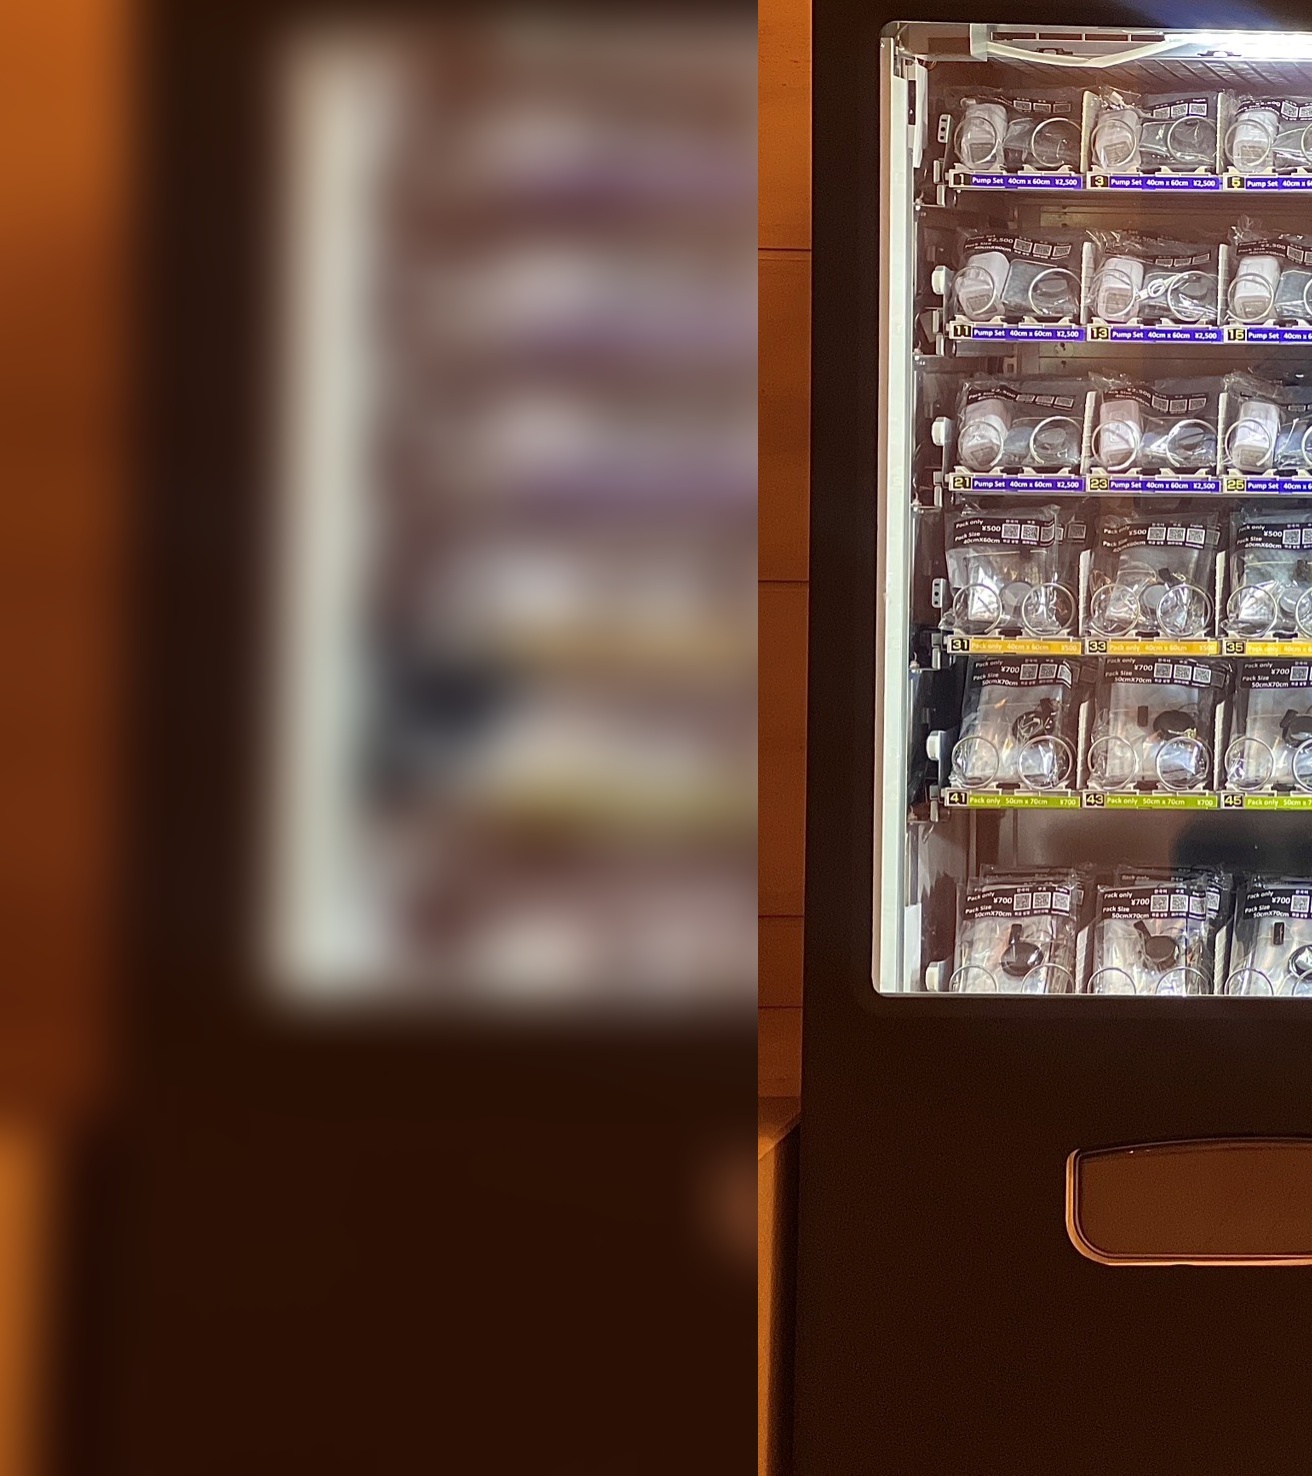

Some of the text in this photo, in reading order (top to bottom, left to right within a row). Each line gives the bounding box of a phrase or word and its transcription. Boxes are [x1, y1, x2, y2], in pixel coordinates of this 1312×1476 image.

[959, 174, 965, 185] 1
[1055, 178, 1078, 186] ¥2,500
[1095, 175, 1104, 186] 3
[1231, 177, 1241, 187] 5
[955, 325, 969, 337] 11
[1092, 328, 1108, 339] 13
[1229, 329, 1245, 340] 15
[954, 478, 969, 489] 21
[1091, 479, 1107, 489] 23
[1193, 482, 1215, 490] ¥2,500
[1228, 480, 1244, 490] 25
[956, 521, 968, 529] Pack
[952, 640, 968, 650] 31
[1090, 641, 1107, 651] 33
[1226, 642, 1244, 653] 35
[1001, 666, 1020, 674] ¥700
[950, 792, 966, 804] 41
[986, 797, 1001, 805] only
[1086, 794, 1104, 805] 43
[1225, 795, 1242, 806] 45
